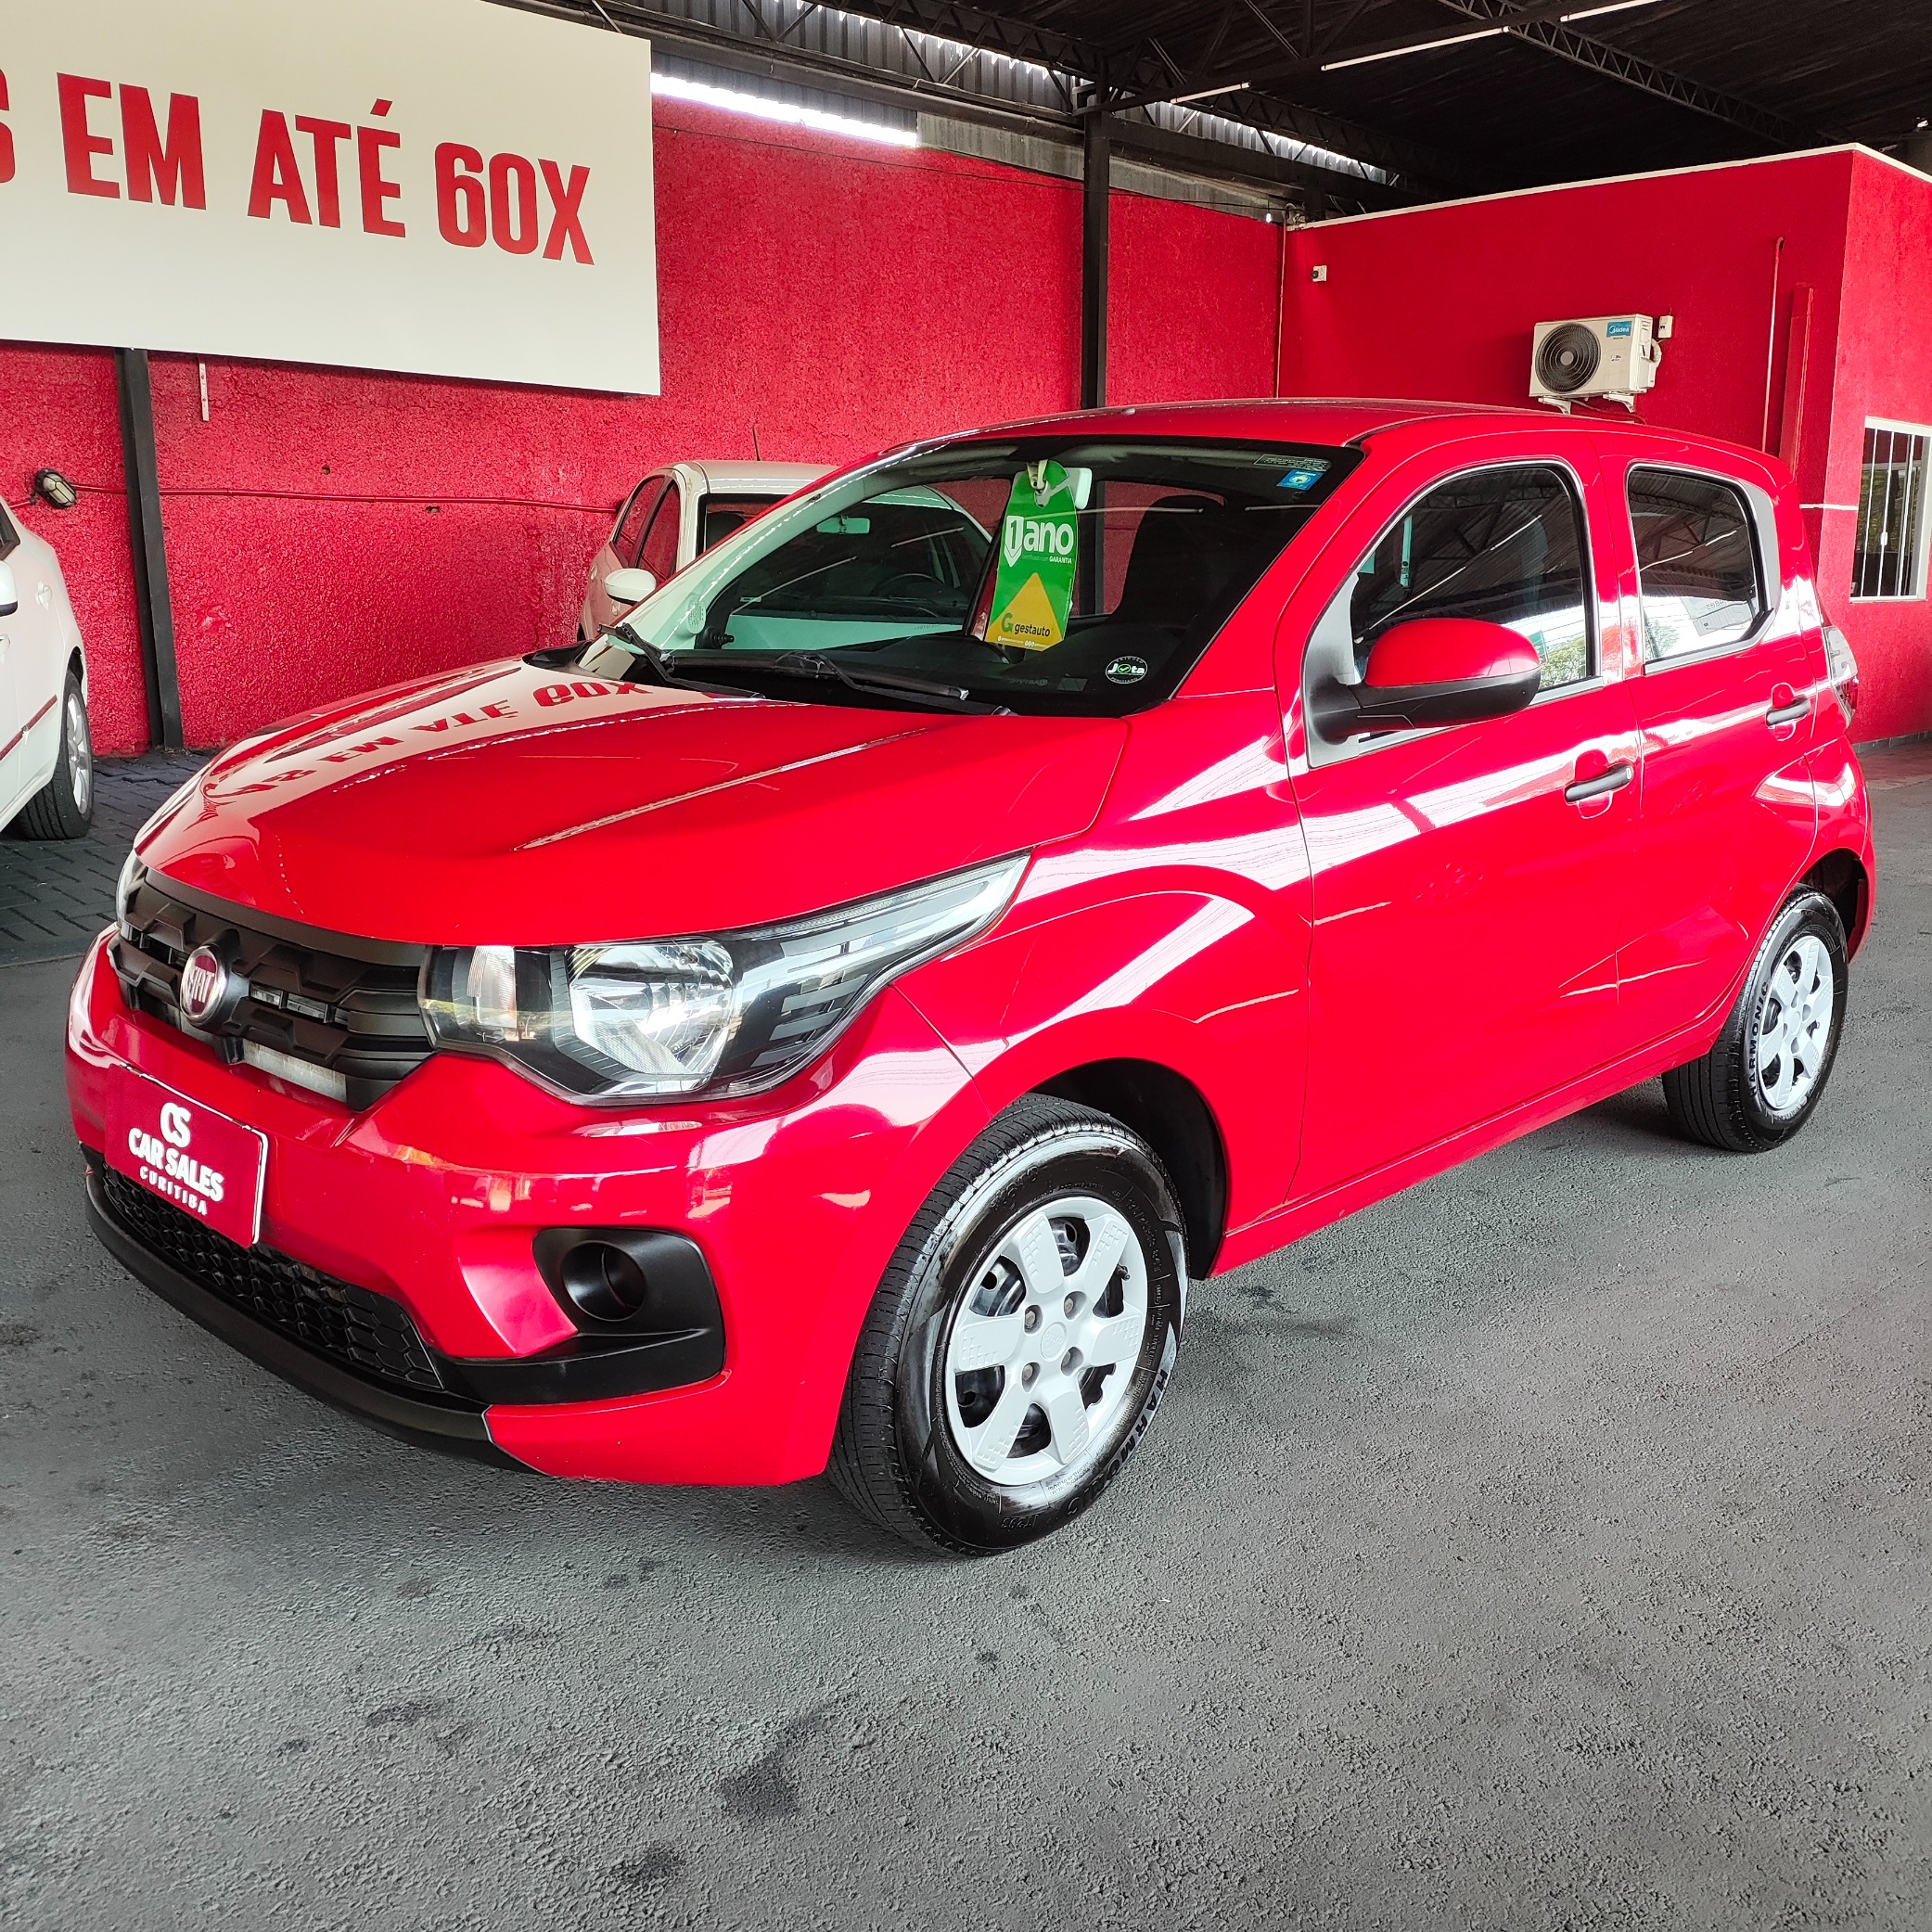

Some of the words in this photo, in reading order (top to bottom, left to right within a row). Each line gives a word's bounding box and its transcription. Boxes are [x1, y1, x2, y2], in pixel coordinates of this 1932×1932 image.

[57, 72, 206, 211] EM
[247, 98, 406, 238] ATÉ
[435, 141, 595, 265] 60X
[1023, 520, 1074, 556] ano
[1014, 623, 1051, 637] gestauto
[186, 966, 215, 1004] FIAT
[160, 1102, 192, 1148] CS
[128, 1128, 163, 1171] CAR
[165, 1150, 224, 1202] SALES
[139, 1165, 209, 1216] CURITIBA
